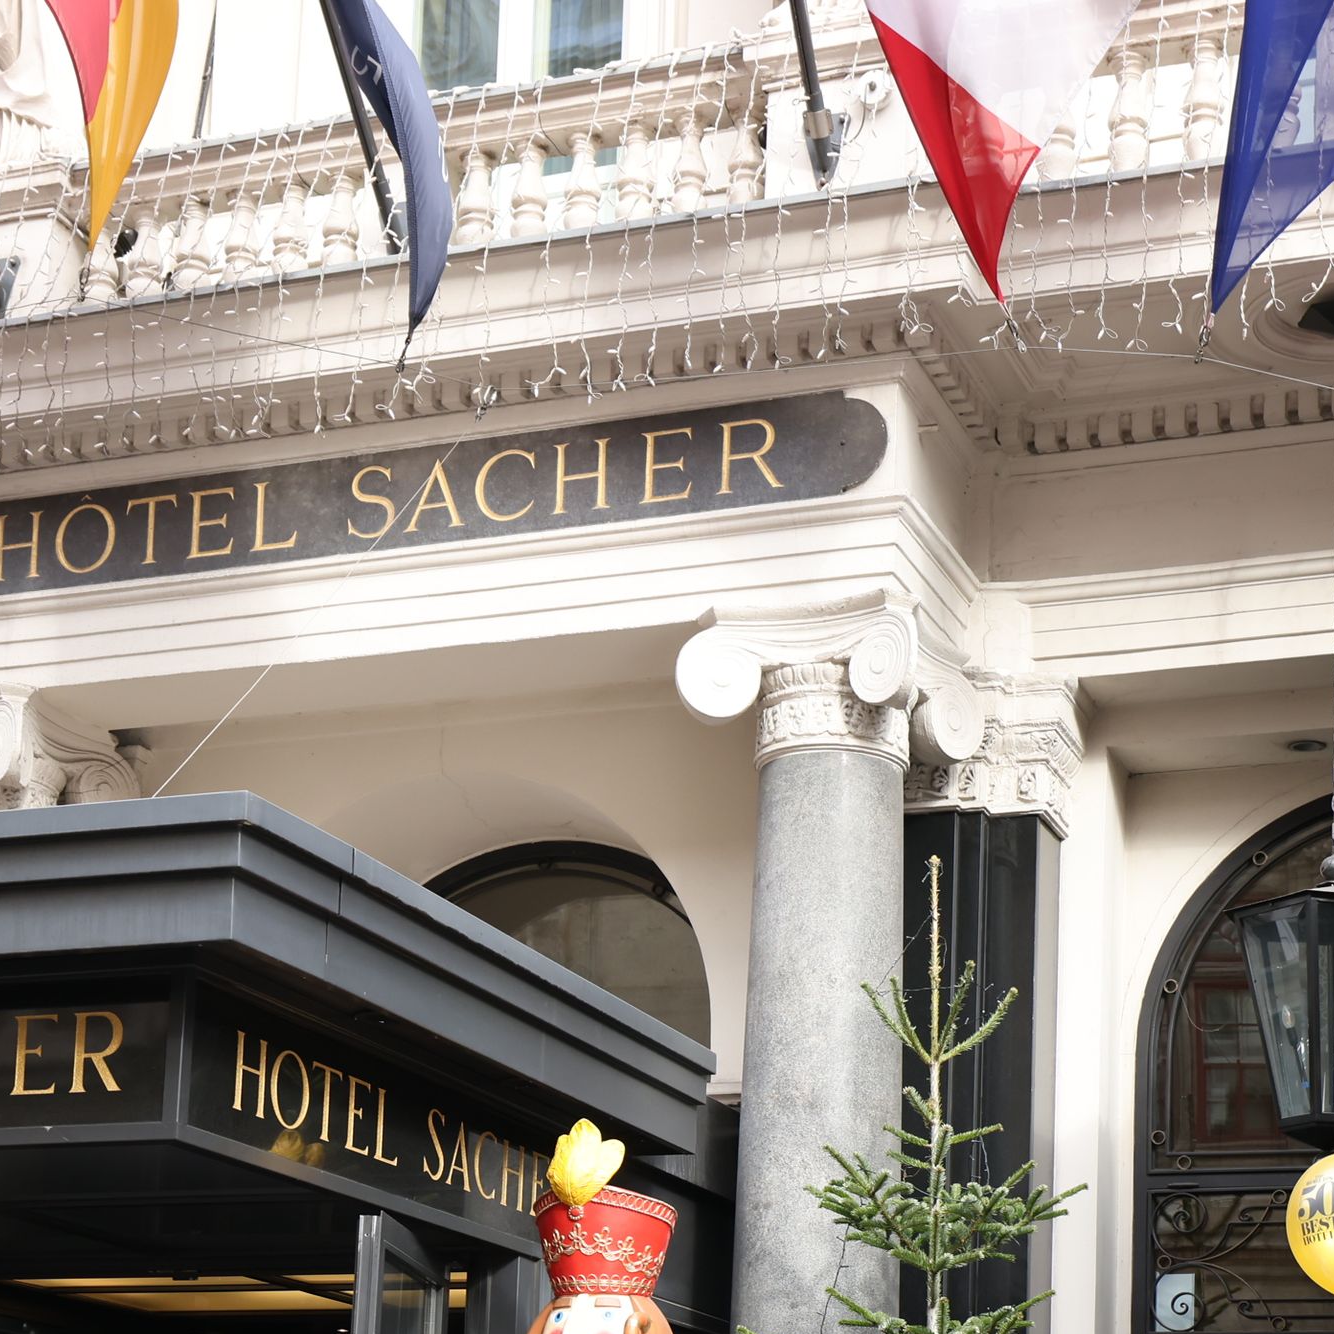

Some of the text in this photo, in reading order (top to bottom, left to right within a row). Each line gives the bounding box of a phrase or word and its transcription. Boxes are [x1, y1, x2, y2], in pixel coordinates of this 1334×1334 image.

[347, 417, 785, 540] SACHER
[232, 1030, 552, 1217] HOTEL SACHE
